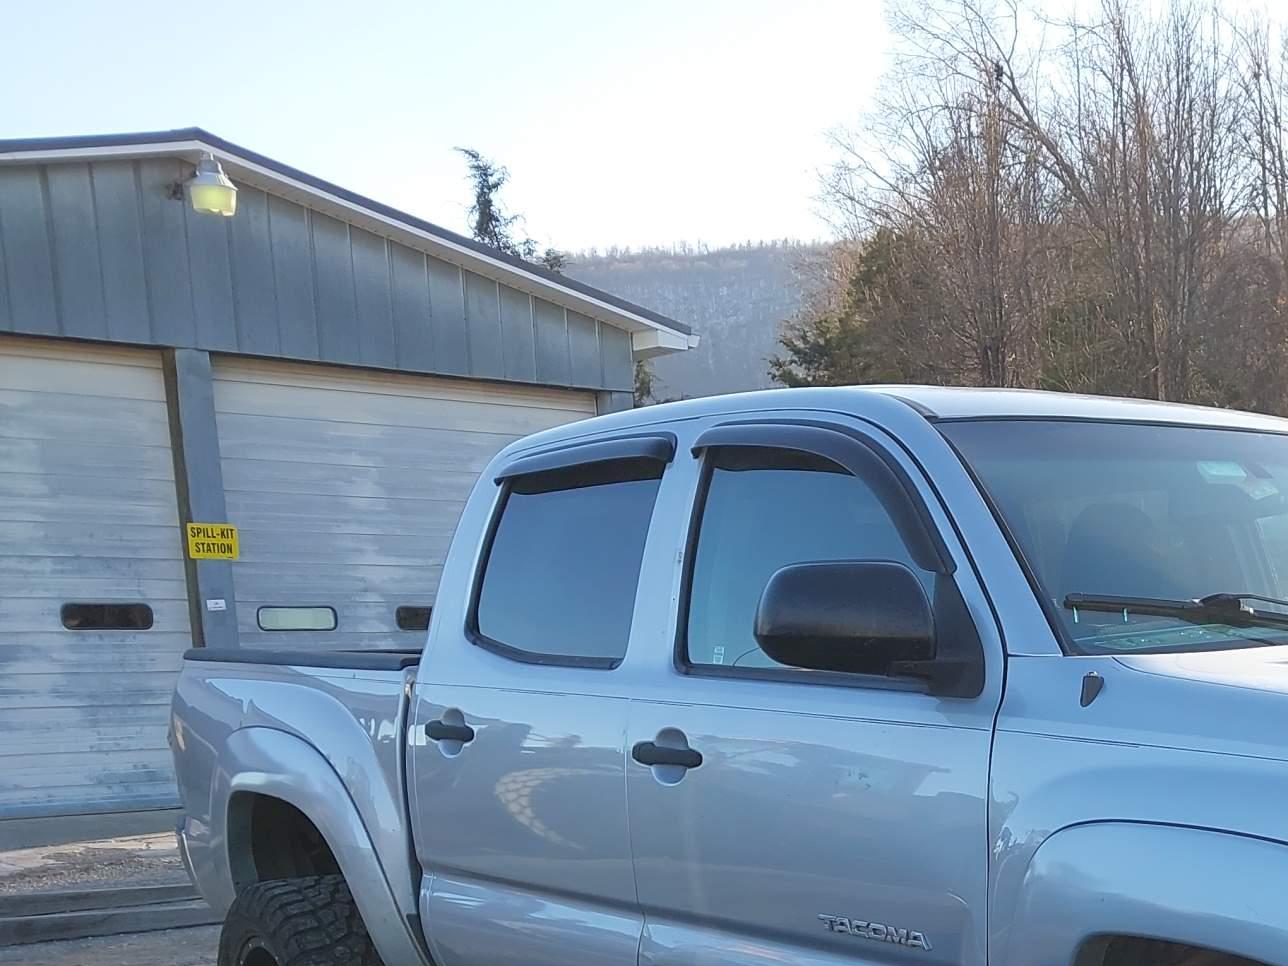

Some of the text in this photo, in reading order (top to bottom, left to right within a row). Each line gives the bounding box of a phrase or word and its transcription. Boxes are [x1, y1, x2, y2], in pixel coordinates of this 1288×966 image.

[190, 526, 235, 540] SPILL-KIT
[195, 542, 233, 554] STATION
[816, 913, 934, 952] TACOMA
